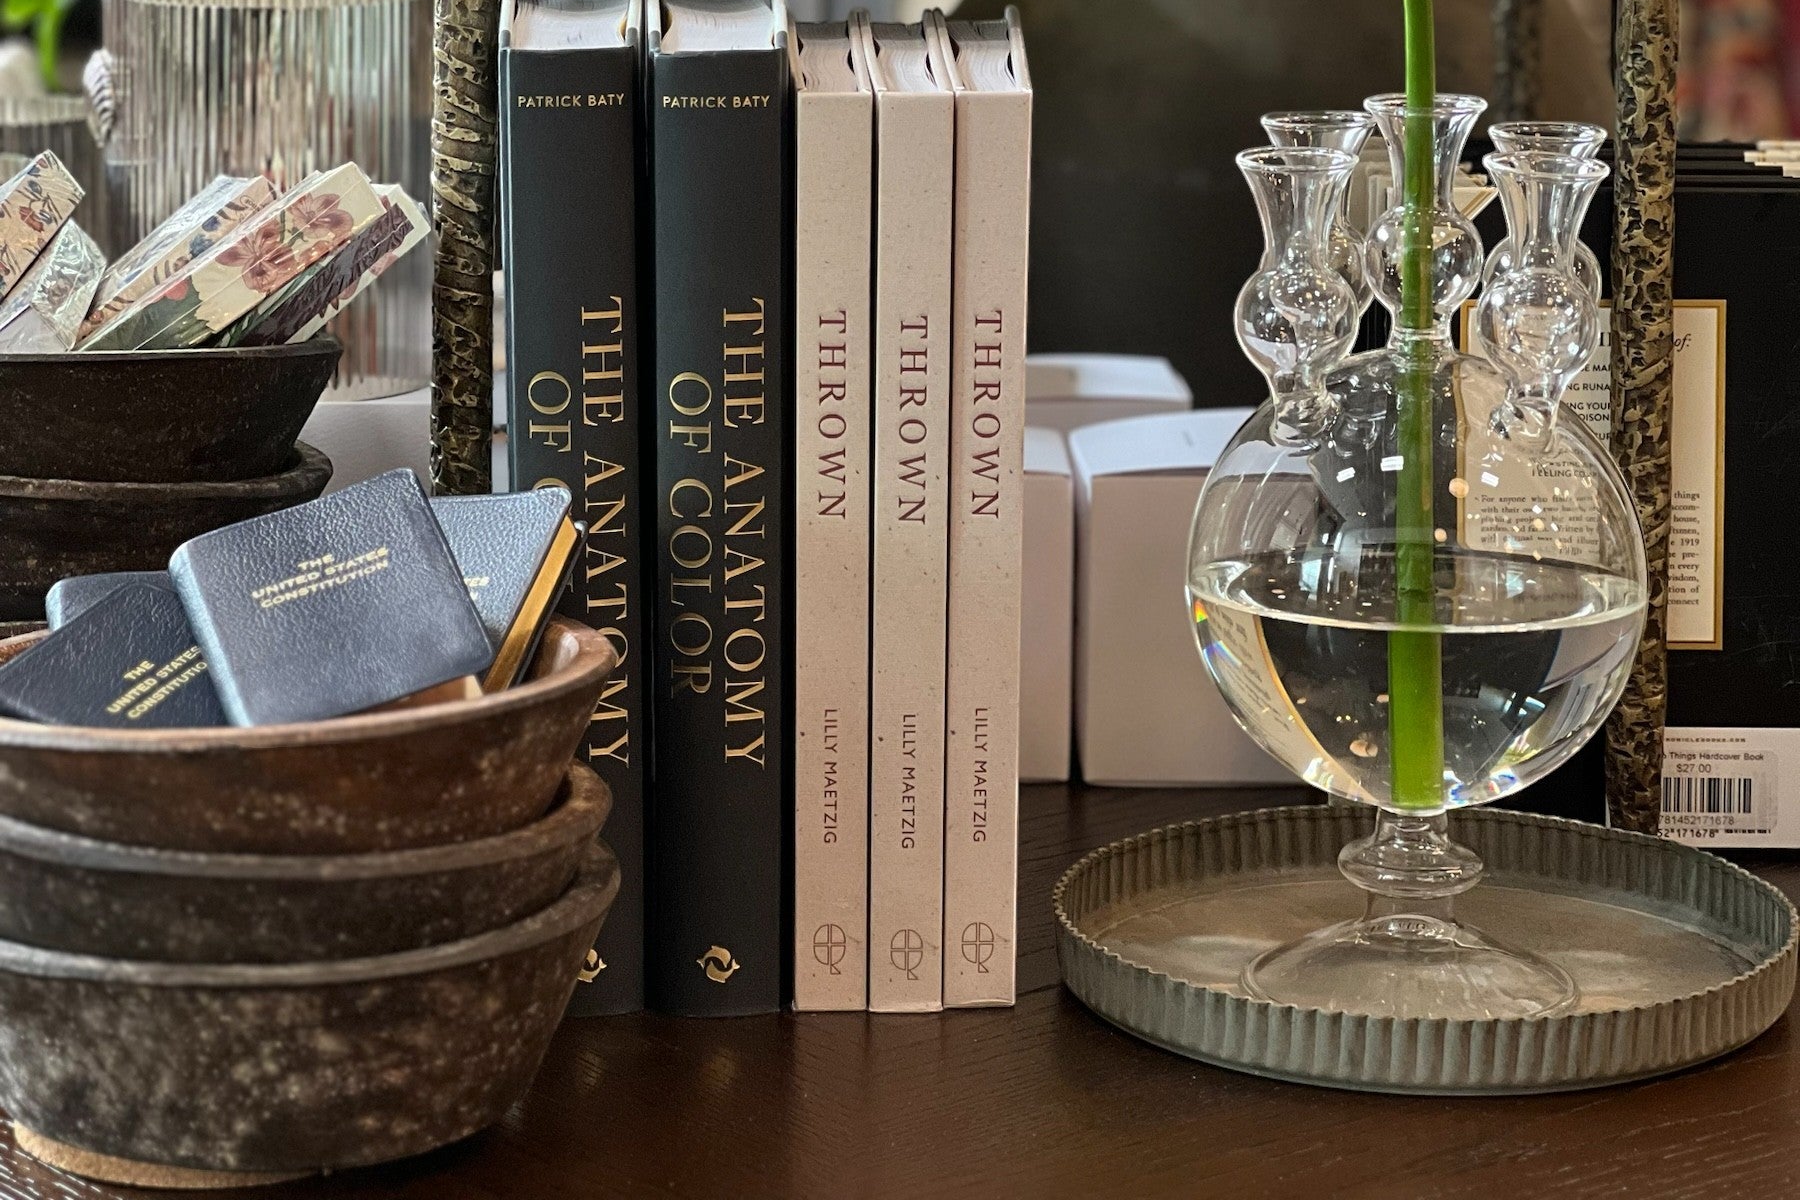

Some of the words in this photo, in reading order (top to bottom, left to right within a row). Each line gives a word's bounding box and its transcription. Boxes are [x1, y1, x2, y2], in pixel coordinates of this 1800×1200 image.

[517, 95, 582, 108] PATRICK
[588, 93, 625, 107] BATY
[663, 96, 726, 109] PATRICK
[732, 95, 770, 109] BATY
[581, 295, 624, 427] THE
[723, 296, 765, 428] THE
[1673, 333, 1692, 352] of:
[528, 370, 572, 453] OF
[669, 371, 712, 454] OF
[817, 310, 847, 521] THROWN
[899, 315, 930, 525] THROWN
[972, 310, 1002, 519] THROWN
[1499, 497, 1527, 505] anyone
[1674, 491, 1700, 502] things
[1673, 514, 1700, 524] house,
[298, 553, 334, 571] THE
[1680, 538, 1700, 547] 1919
[1682, 551, 1700, 561] pre-
[251, 571, 321, 599] UNITED
[324, 546, 389, 576] STATES
[260, 559, 389, 608] CONSTITUTION
[669, 478, 713, 700] COLOR
[1677, 562, 1700, 573] every
[1690, 584, 1700, 594] of
[584, 450, 630, 769] ANATOMY
[723, 452, 766, 770] ANATOMY
[106, 677, 158, 713] UNITED
[155, 645, 201, 679] STATES
[123, 660, 155, 680] THE
[127, 661, 208, 718] CONSTITUTIO
[823, 708, 838, 754] LILLY
[901, 714, 916, 759] LILLY
[973, 708, 989, 753] LILLY
[1668, 751, 1696, 762] Things
[1699, 752, 1742, 761] Hardcover
[1743, 752, 1765, 761] Book
[1675, 763, 1712, 774] $2700
[823, 761, 838, 845] MAETZIG
[901, 766, 916, 850] MAETZIG
[972, 760, 988, 844] MAETZIG
